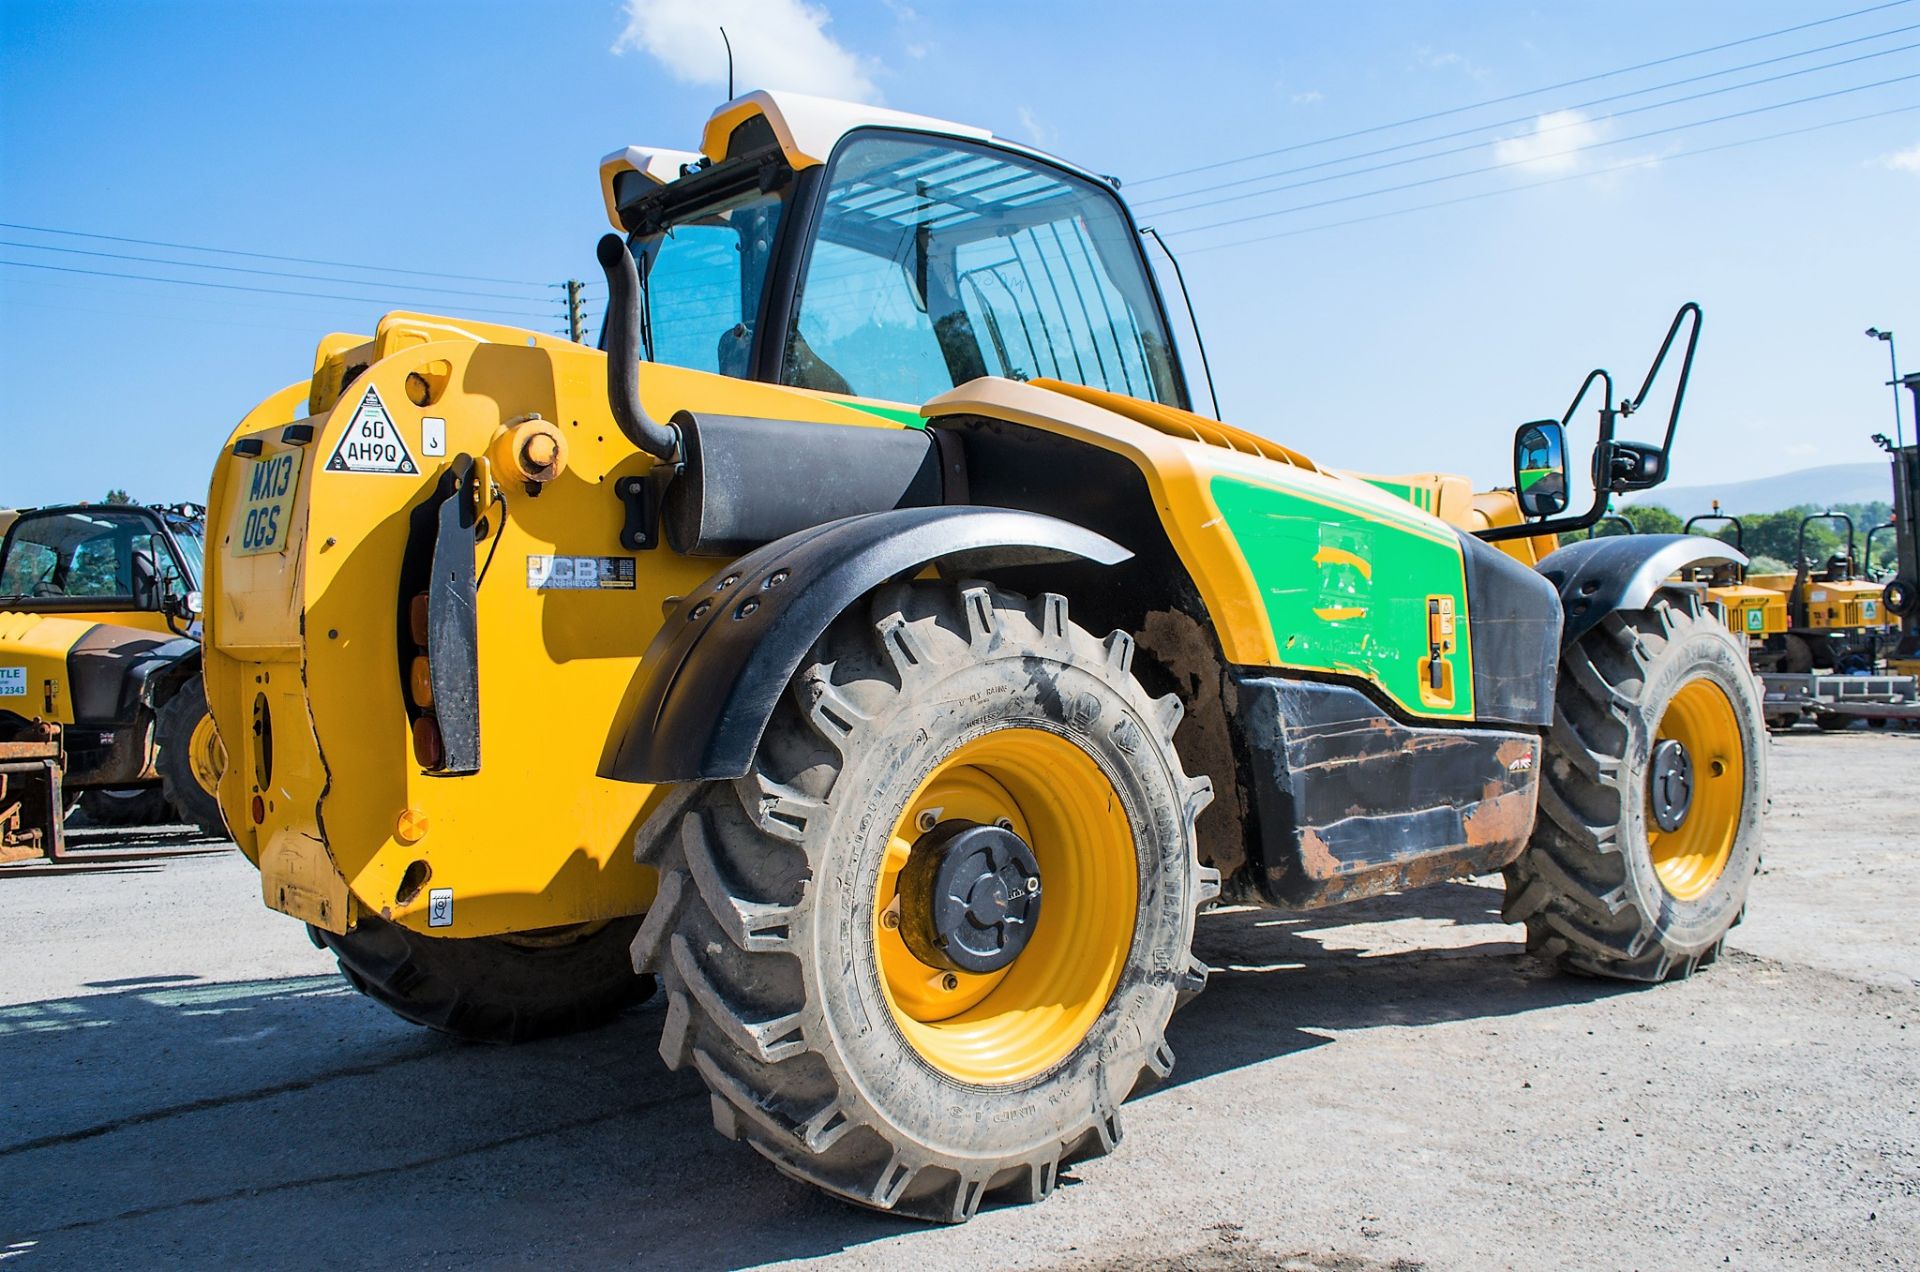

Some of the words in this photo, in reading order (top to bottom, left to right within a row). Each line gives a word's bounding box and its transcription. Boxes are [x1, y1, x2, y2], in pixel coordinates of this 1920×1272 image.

[348, 442, 396, 462] AH9Q
[249, 455, 292, 502] MX13
[243, 505, 280, 549] OGS
[528, 556, 599, 580] JCB
